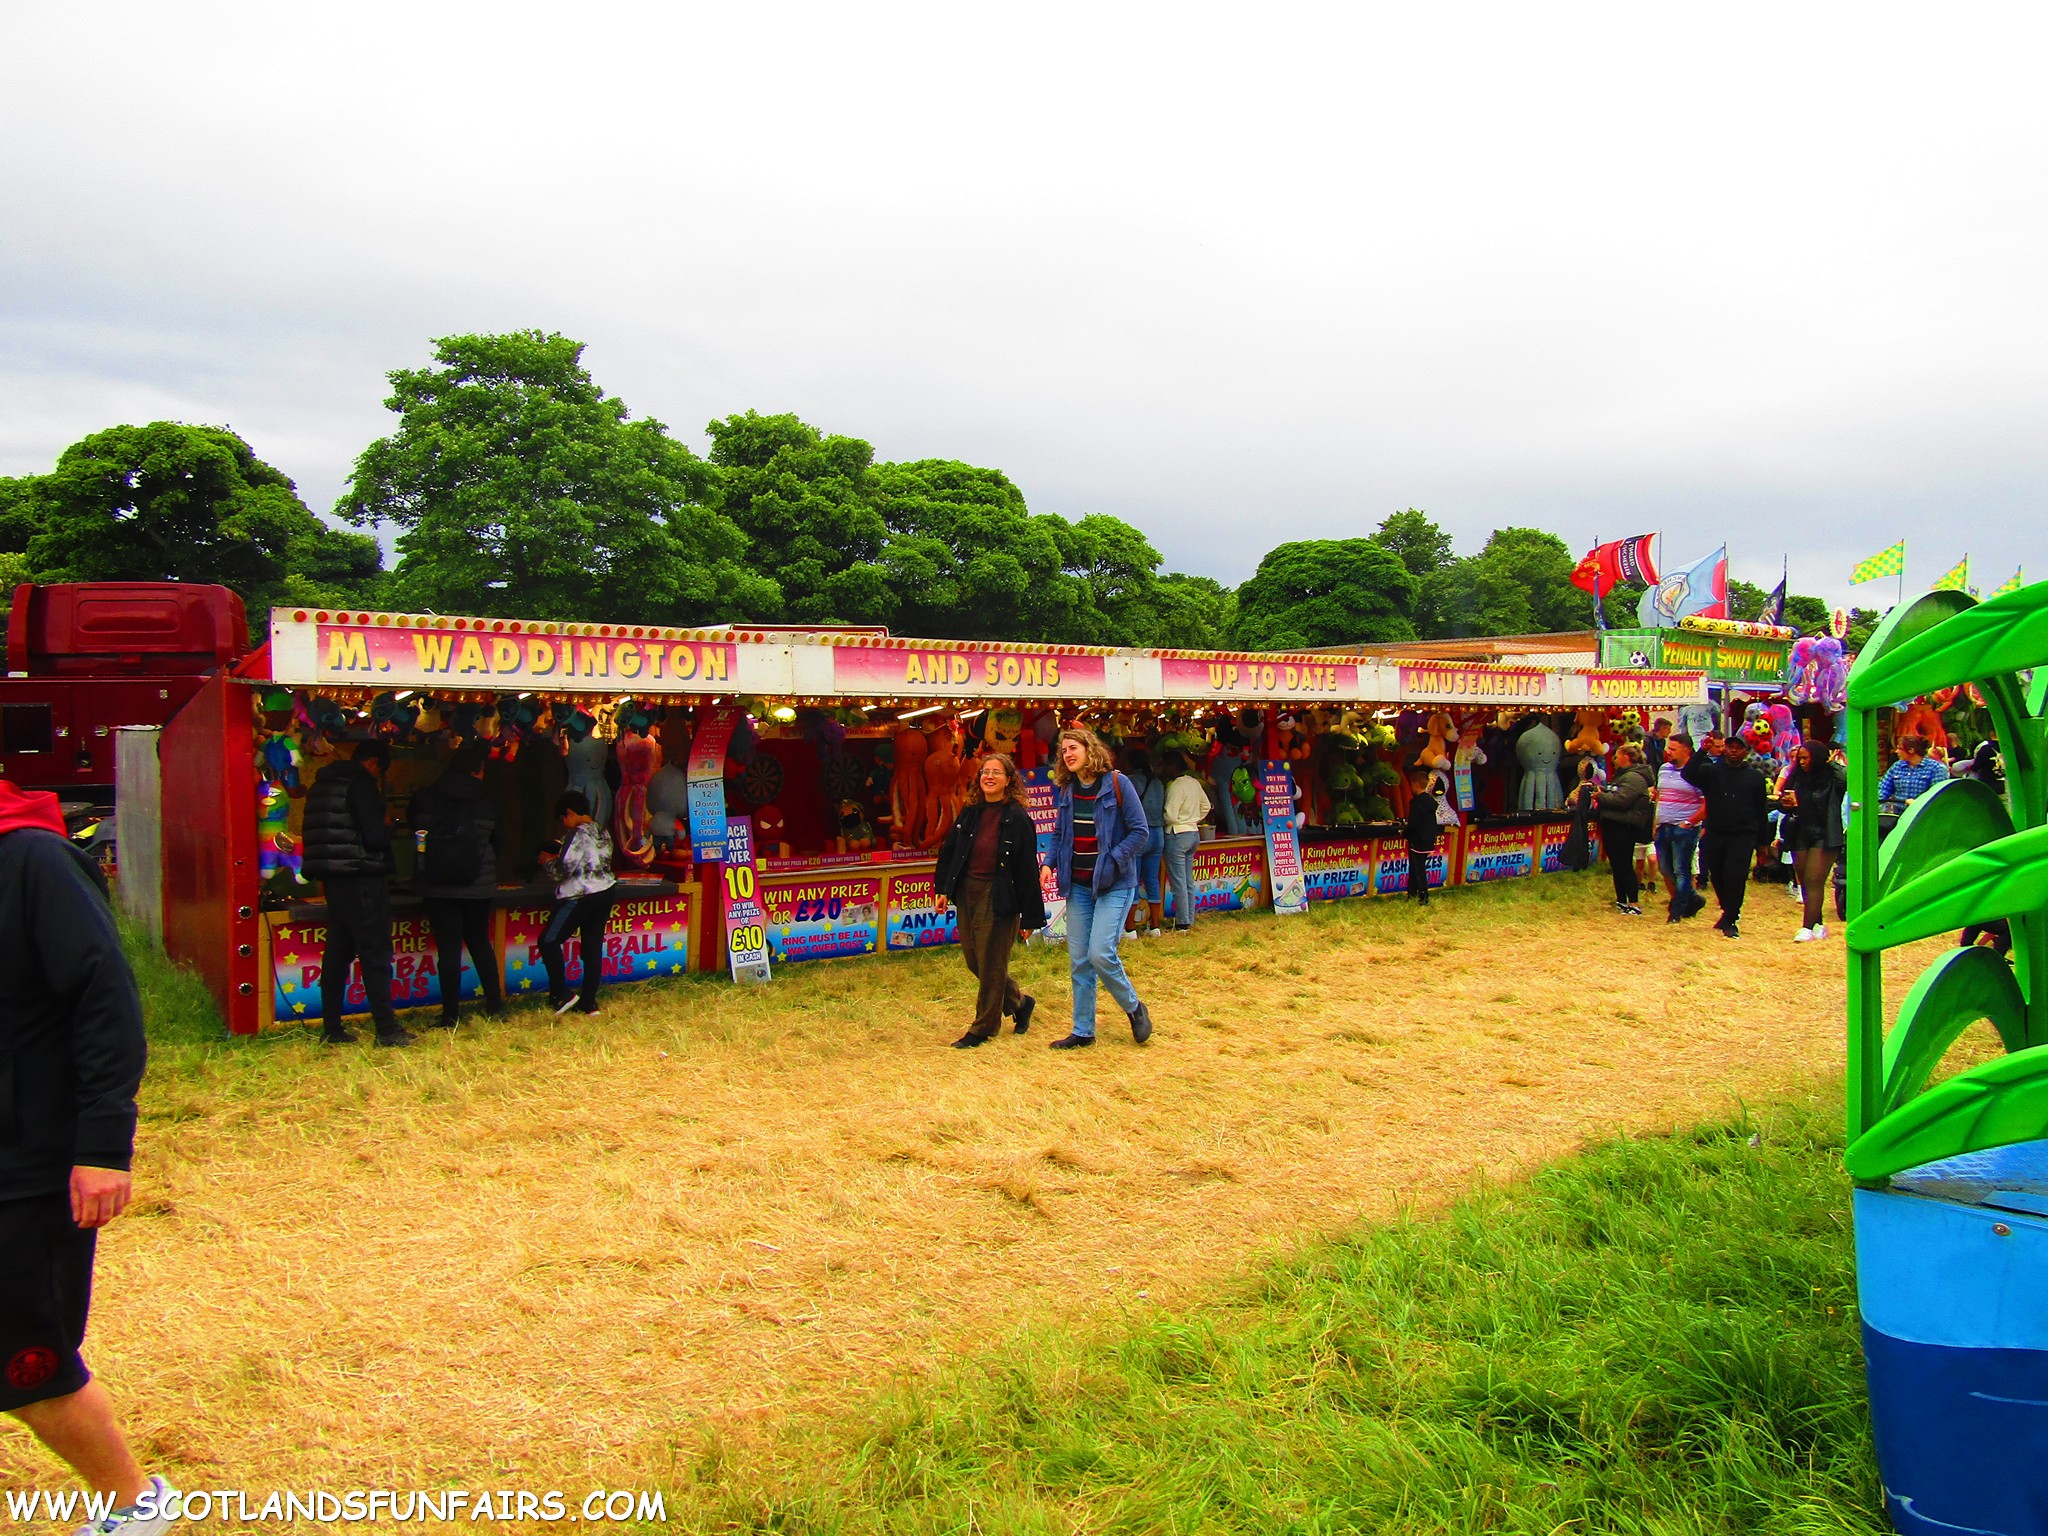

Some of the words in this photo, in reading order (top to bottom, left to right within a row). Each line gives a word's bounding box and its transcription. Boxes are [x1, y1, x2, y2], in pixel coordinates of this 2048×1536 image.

[327, 631, 391, 672] M.
[412, 634, 729, 681] WADDINGTON
[1663, 641, 1713, 666] PENALTY
[1716, 646, 1754, 669] SHOOT
[1756, 650, 1781, 671] OUT
[905, 653, 971, 686] AND
[984, 656, 1062, 687] SONS
[1208, 664, 1238, 690] UP
[1249, 665, 1276, 690] TO
[1286, 666, 1337, 692] DATE
[1408, 671, 1541, 696] AMUSEMENTS
[1590, 680, 1601, 697] 4
[1602, 680, 1640, 698] YOUR
[1641, 680, 1700, 699] PLEASURE
[1265, 785, 1288, 793] CRAZY
[695, 800, 719, 808] Down
[1028, 809, 1058, 821] UCKET
[1268, 808, 1290, 816] GAME!
[701, 818, 717, 826] BIG
[1036, 823, 1056, 833] AME!
[1547, 823, 1571, 835] QUALIT
[698, 828, 721, 836] Prize
[727, 825, 747, 838] ACH
[1276, 832, 1292, 841] BALL
[1478, 834, 1481, 843] 1
[1484, 832, 1499, 843] Ring
[1500, 832, 1514, 841] Over
[1515, 830, 1525, 839] the
[728, 838, 749, 851] ART
[1301, 848, 1304, 858] 1
[1307, 847, 1326, 859] Ring
[1326, 845, 1344, 856] Over
[1347, 843, 1359, 855] the
[808, 857, 821, 866] £20
[1194, 854, 1206, 867] all
[1207, 855, 1217, 865] in
[1220, 851, 1252, 863] Bucket
[1303, 860, 1328, 872] Bottle
[1329, 860, 1338, 869] to
[1338, 857, 1355, 868] Win
[1380, 859, 1408, 874] CASH
[1425, 856, 1443, 868] ZES
[1473, 856, 1494, 869] ANY
[1495, 853, 1525, 866] PRIZE!
[1544, 857, 1557, 870] TO
[1213, 867, 1221, 878] A
[1222, 864, 1252, 877] PRIZE
[1281, 866, 1298, 875] CASH!
[1482, 867, 1496, 878] OR
[1498, 865, 1514, 878] £10
[724, 866, 755, 900] 10
[1304, 873, 1321, 887] NY
[1323, 870, 1359, 884] PRIZE!
[1380, 875, 1397, 890] TO
[764, 889, 792, 904] WIN
[797, 887, 827, 901] ANY
[830, 883, 869, 898] PRIZE
[894, 880, 930, 895] Score
[1307, 887, 1325, 899] OR
[1327, 884, 1347, 898] £10
[732, 902, 741, 910] TO
[742, 901, 755, 910] WIN
[901, 894, 932, 911] Each
[1194, 892, 1231, 909] CASH!
[526, 910, 551, 926] TR
[627, 899, 674, 917] SKILL
[728, 910, 741, 919] ANY
[742, 908, 760, 917] PRIZE
[772, 911, 791, 925] OR
[795, 897, 842, 922] £20
[740, 916, 750, 924] OR
[901, 912, 938, 930] ANY
[298, 927, 327, 944] TR
[730, 925, 764, 953] £10
[782, 936, 806, 946] RING
[809, 933, 837, 944] MUST
[838, 932, 850, 942] BE
[852, 930, 869, 939] ALL
[920, 927, 946, 945] OR
[787, 945, 809, 955] WAY
[811, 942, 836, 953] OVER
[838, 940, 863, 950] POST
[737, 954, 745, 963] IN
[745, 952, 761, 962] CASH
[565, 954, 635, 981] GNS
[347, 976, 430, 1005] GNS
